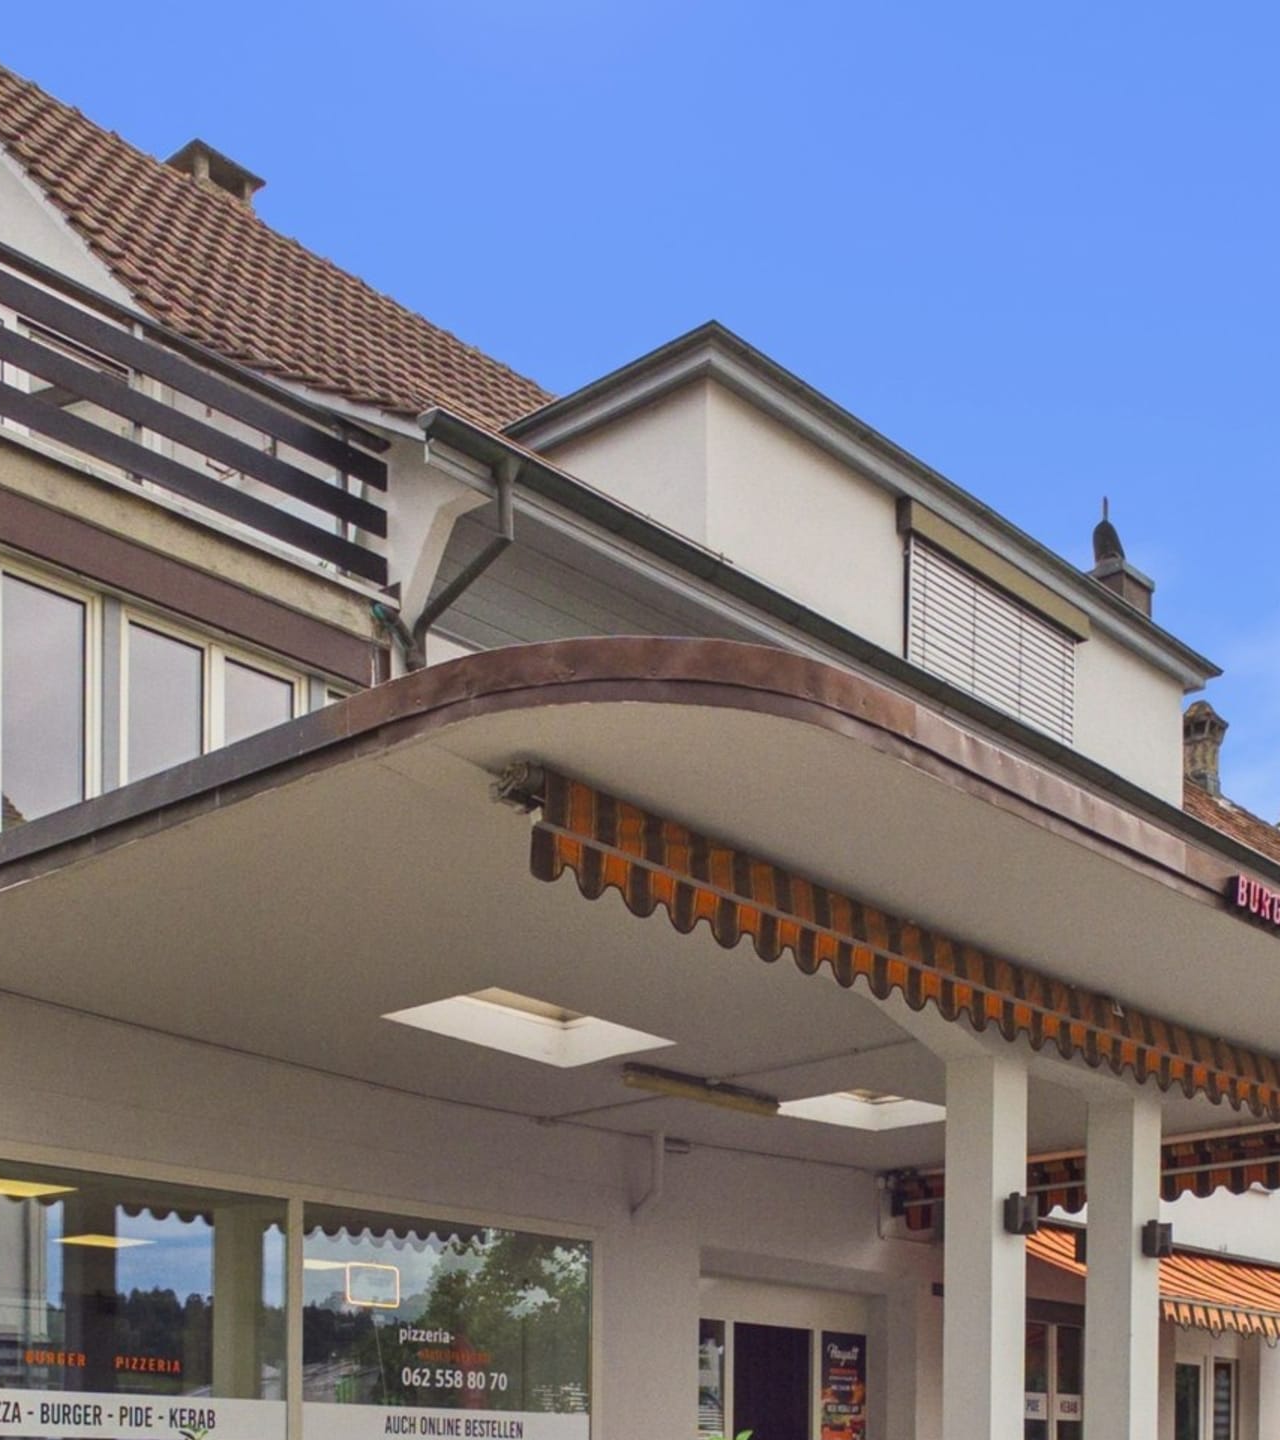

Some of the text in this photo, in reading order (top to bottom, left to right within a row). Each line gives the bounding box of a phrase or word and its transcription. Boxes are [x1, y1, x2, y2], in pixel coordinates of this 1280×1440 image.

[24, 1350, 182, 1373] BURGER PIZZERIA
[401, 1367, 508, 1391] 062 558 80 70
[40, 1402, 102, 1427] BURGER
[119, 1405, 153, 1428] PIDE
[169, 1407, 216, 1430] KEBAB
[384, 1415, 524, 1439] AUCH ONLINE BESTELLEN
